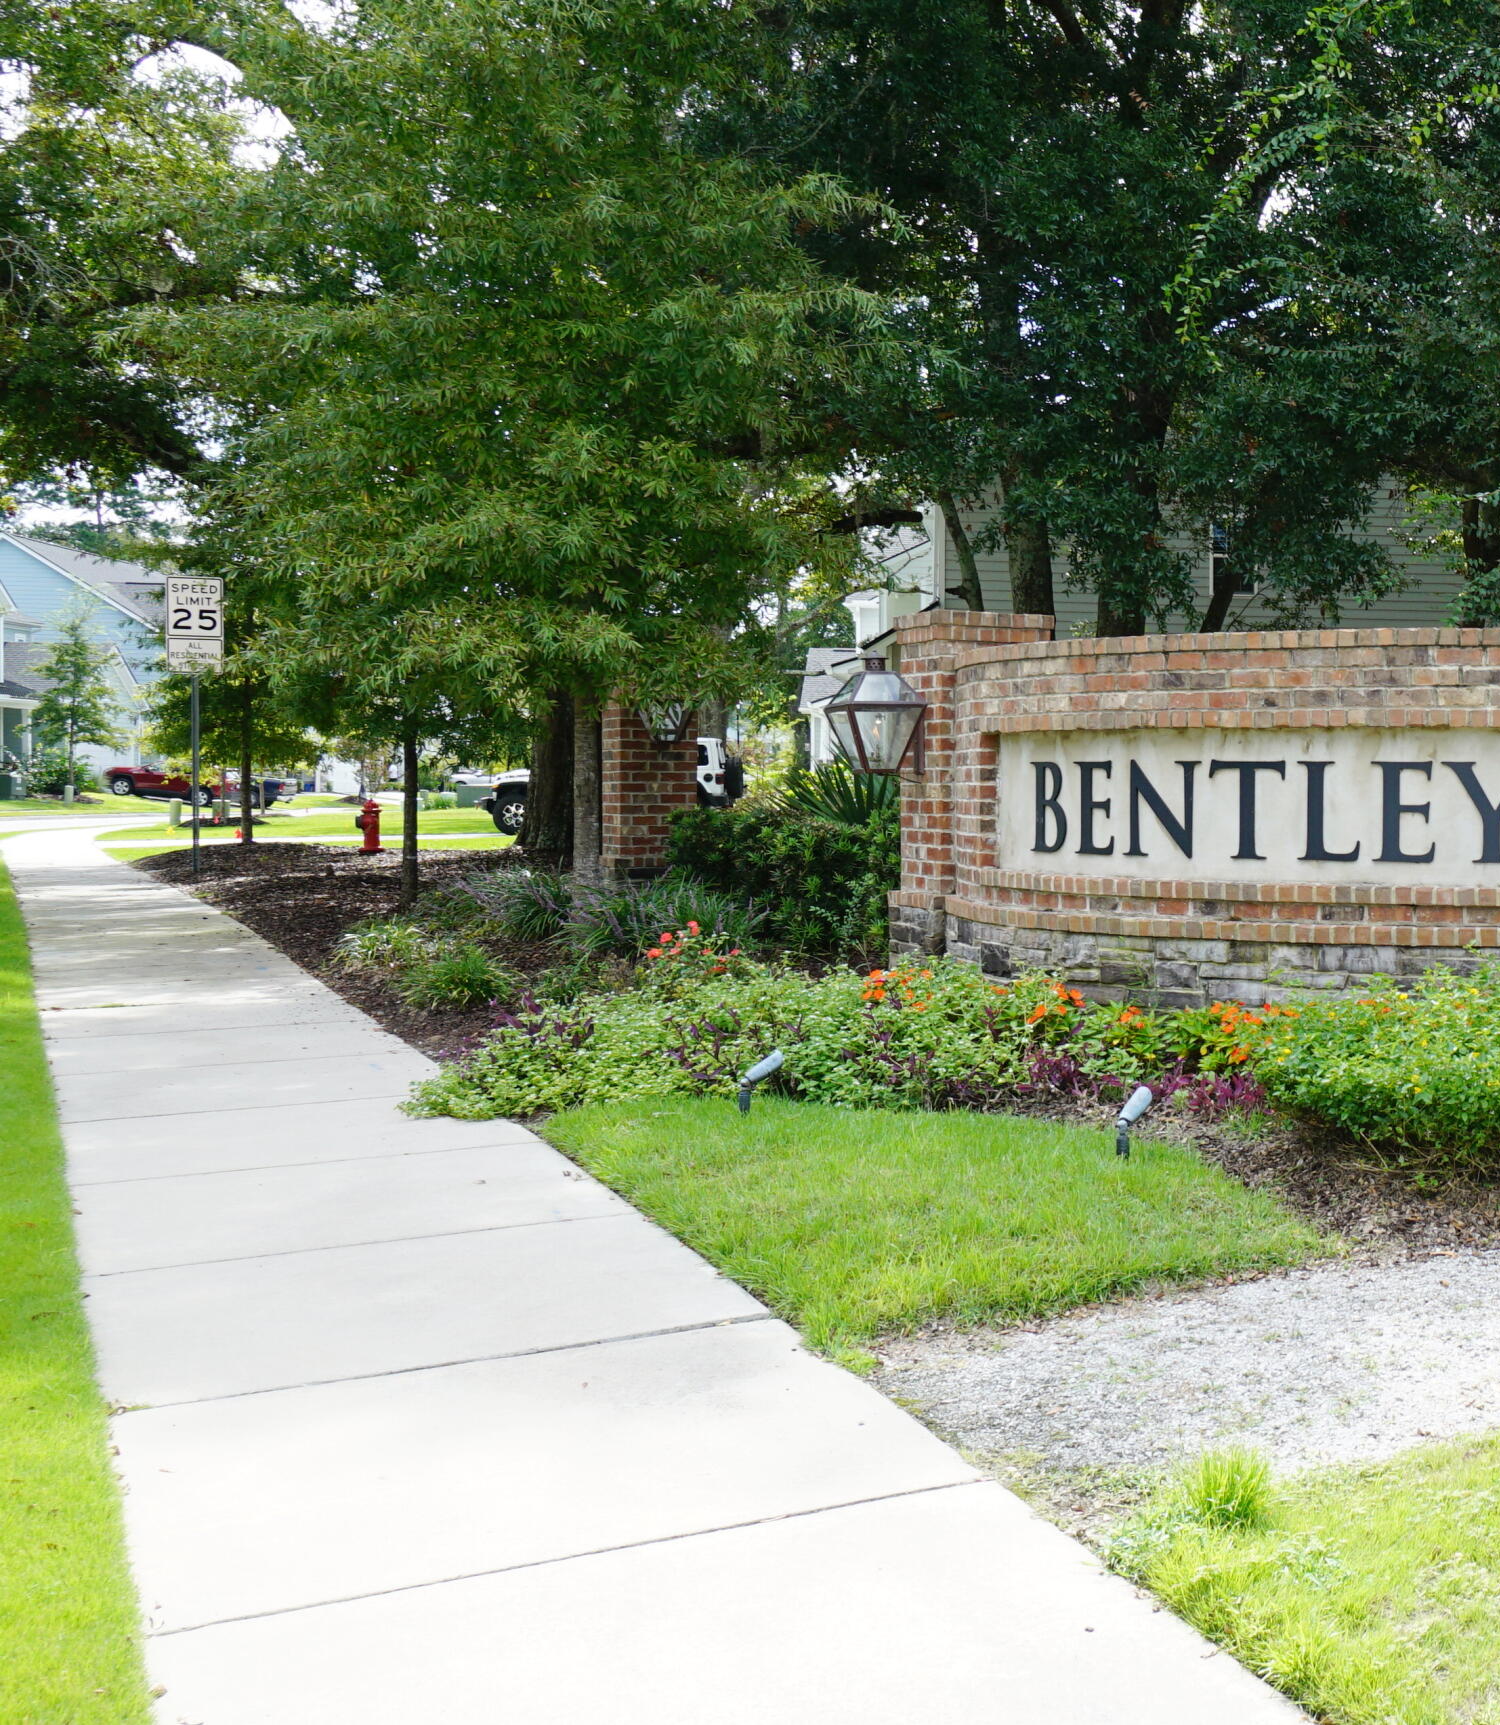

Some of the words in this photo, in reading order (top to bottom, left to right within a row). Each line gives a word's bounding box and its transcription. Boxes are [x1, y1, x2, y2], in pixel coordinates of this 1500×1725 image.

[171, 583, 218, 594] SPEED
[176, 596, 212, 606] LIMIT
[173, 608, 217, 631] 25
[188, 641, 203, 650] ALL
